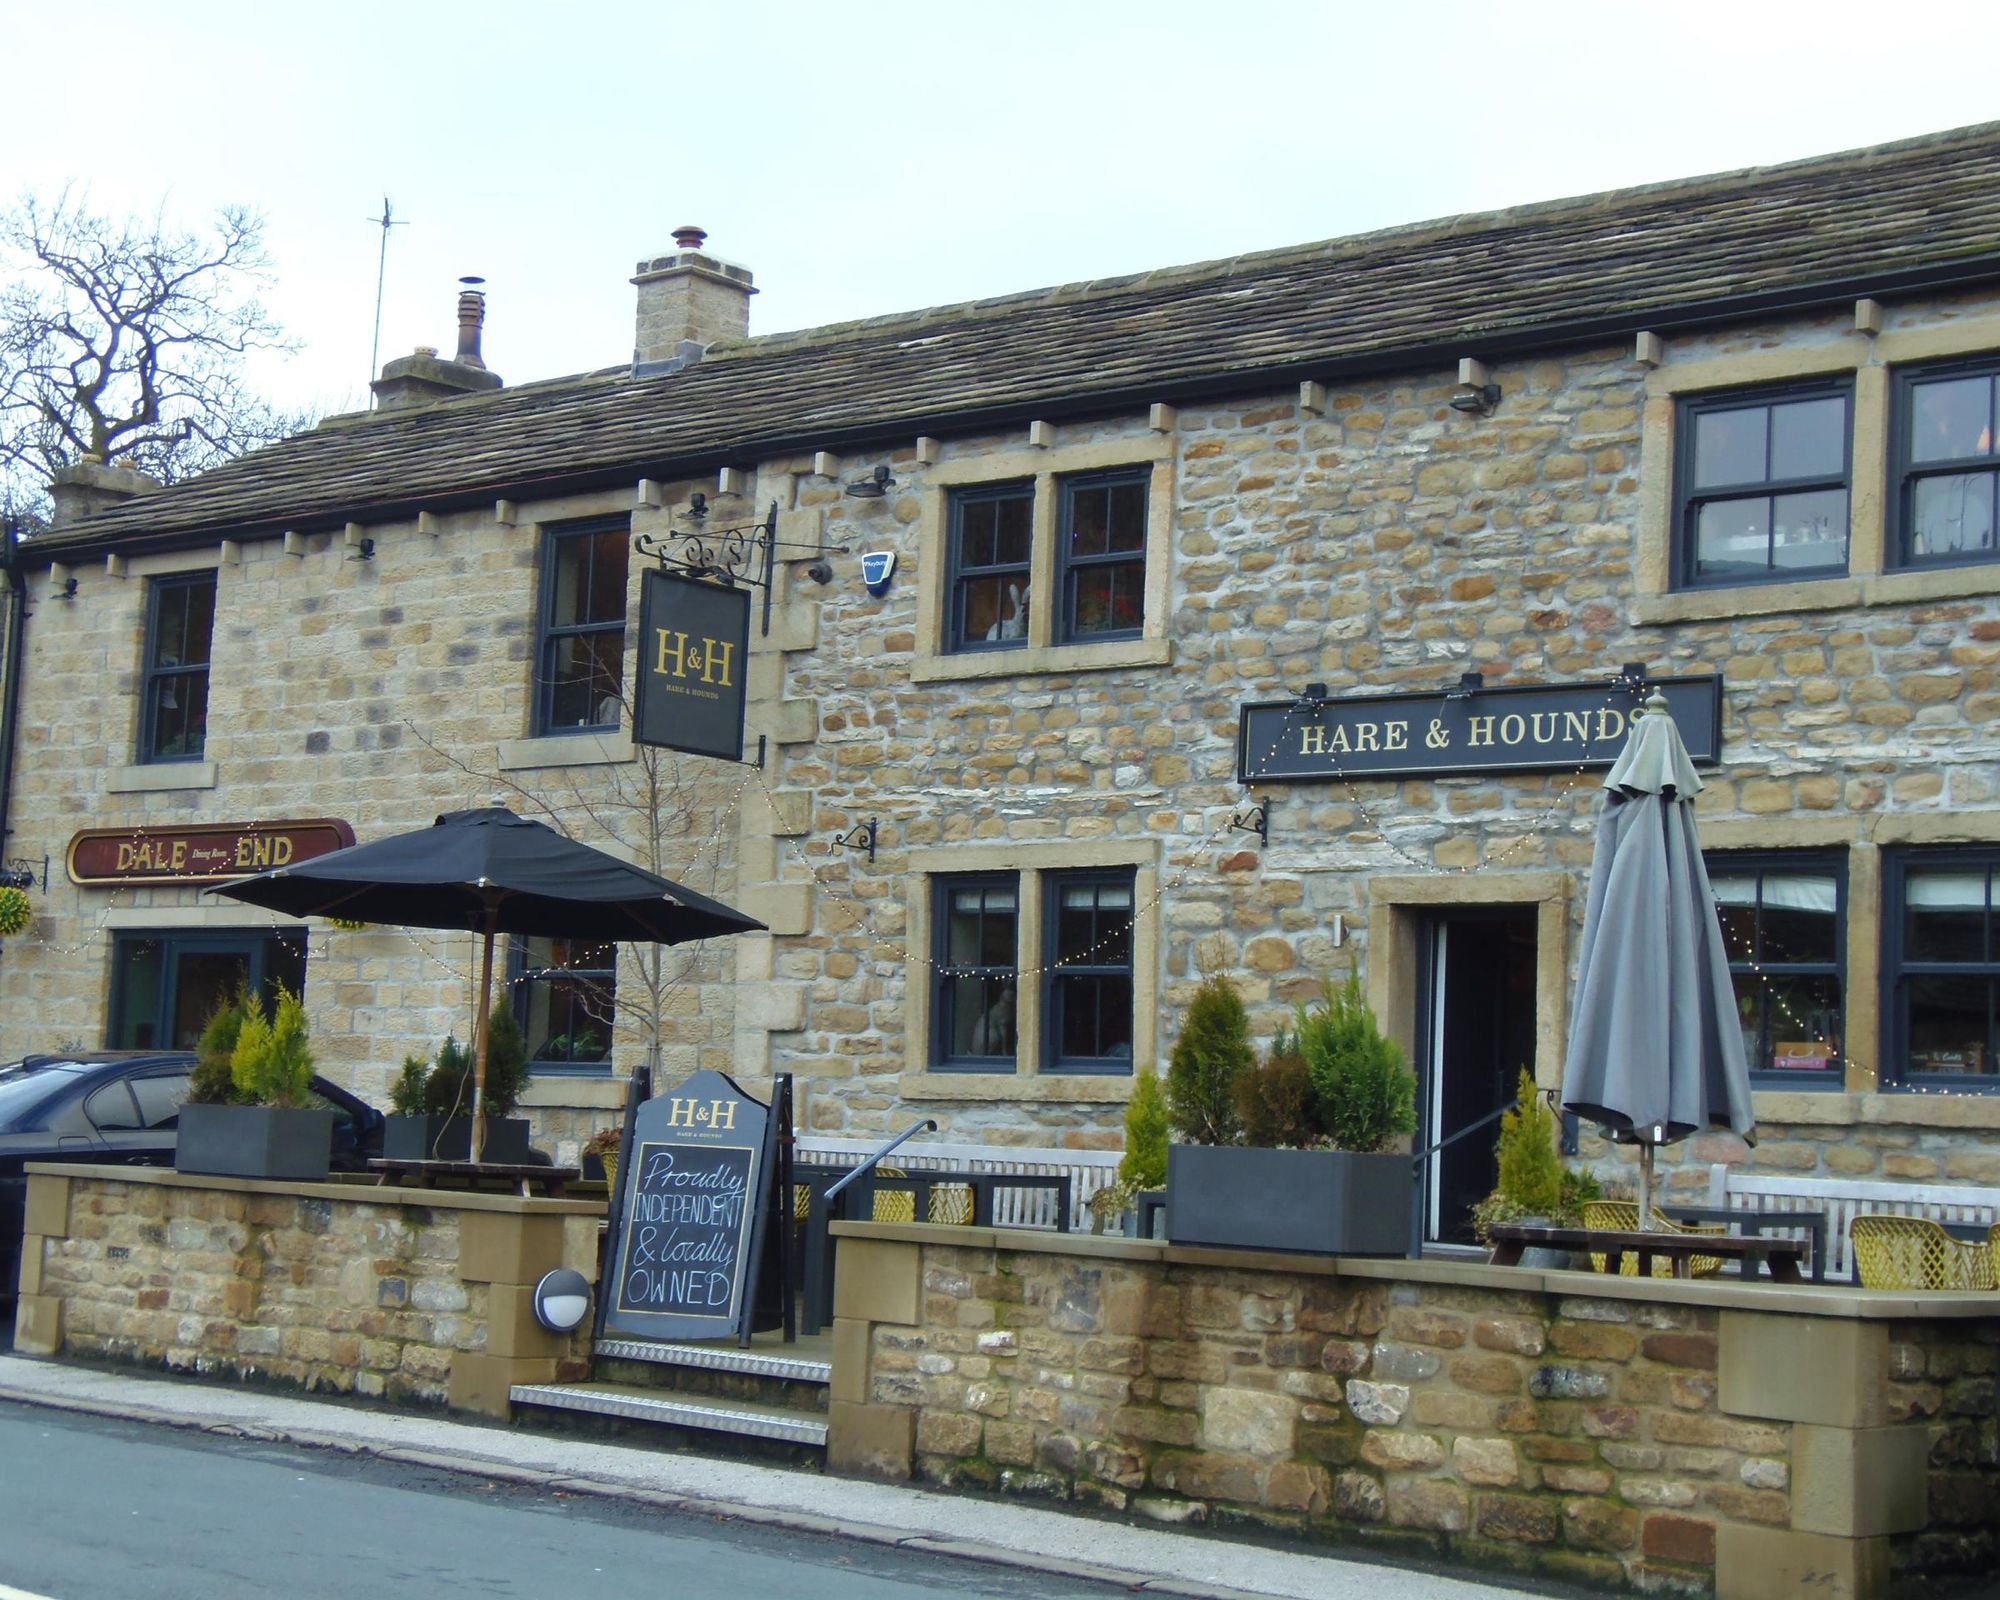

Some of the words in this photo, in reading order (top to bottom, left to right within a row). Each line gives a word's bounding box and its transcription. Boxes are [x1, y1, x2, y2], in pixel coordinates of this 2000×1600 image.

[653, 627, 734, 687] H&H
[1299, 720, 1408, 755] HARE
[1425, 718, 1450, 749] &
[116, 841, 188, 871] DALE
[235, 836, 293, 867] END
[666, 1097, 739, 1130] H&H
[644, 1152, 746, 1209] Proudly
[632, 1192, 745, 1229] INDEPENDENT
[633, 1226, 657, 1267] &
[627, 1269, 730, 1306] OWNED
